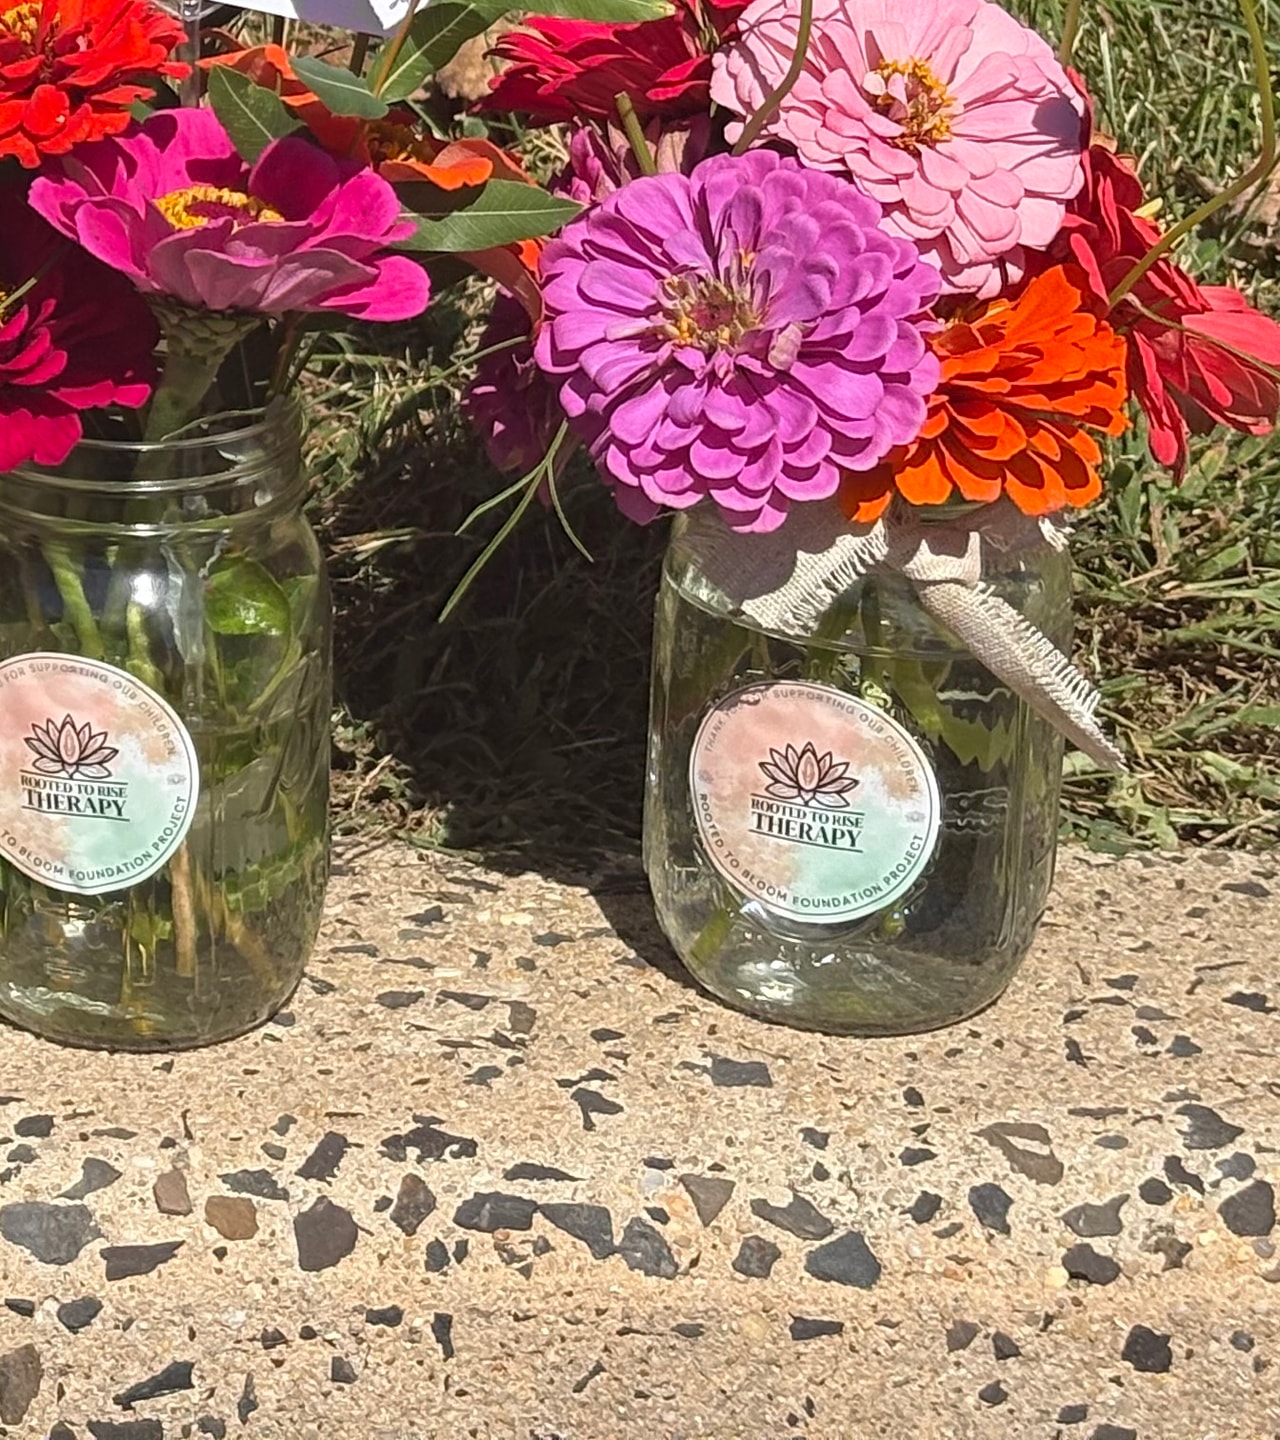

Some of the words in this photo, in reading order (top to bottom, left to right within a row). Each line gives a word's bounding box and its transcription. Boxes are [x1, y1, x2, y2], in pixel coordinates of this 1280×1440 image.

[4, 667, 26, 683] FOR
[28, 663, 109, 684] SUPPORTING
[111, 679, 137, 701] OUR
[139, 699, 178, 756] CHILDREN
[705, 719, 727, 753] THANK
[773, 689, 856, 716] SUPPORTING
[858, 712, 885, 735] OUR
[883, 734, 920, 794] CHILDREN
[21, 774, 74, 794] ROOTED
[77, 780, 95, 796] TO
[97, 784, 128, 798] RISE
[22, 786, 127, 817] THERAPY
[751, 798, 807, 820] ROOTED
[809, 809, 830, 826] TO
[832, 813, 865, 829] RISE
[1, 830, 17, 848] TO
[18, 845, 64, 877] BLOOM
[68, 851, 154, 882] FOUNDATION
[151, 795, 188, 852] PROJECT
[699, 793, 725, 849] ROOTED
[725, 851, 740, 869] TO
[741, 868, 788, 902] BLOOM
[792, 882, 883, 909] FOUNDATION
[882, 833, 924, 887] PROJECT
[752, 811, 863, 849] THERAPY
